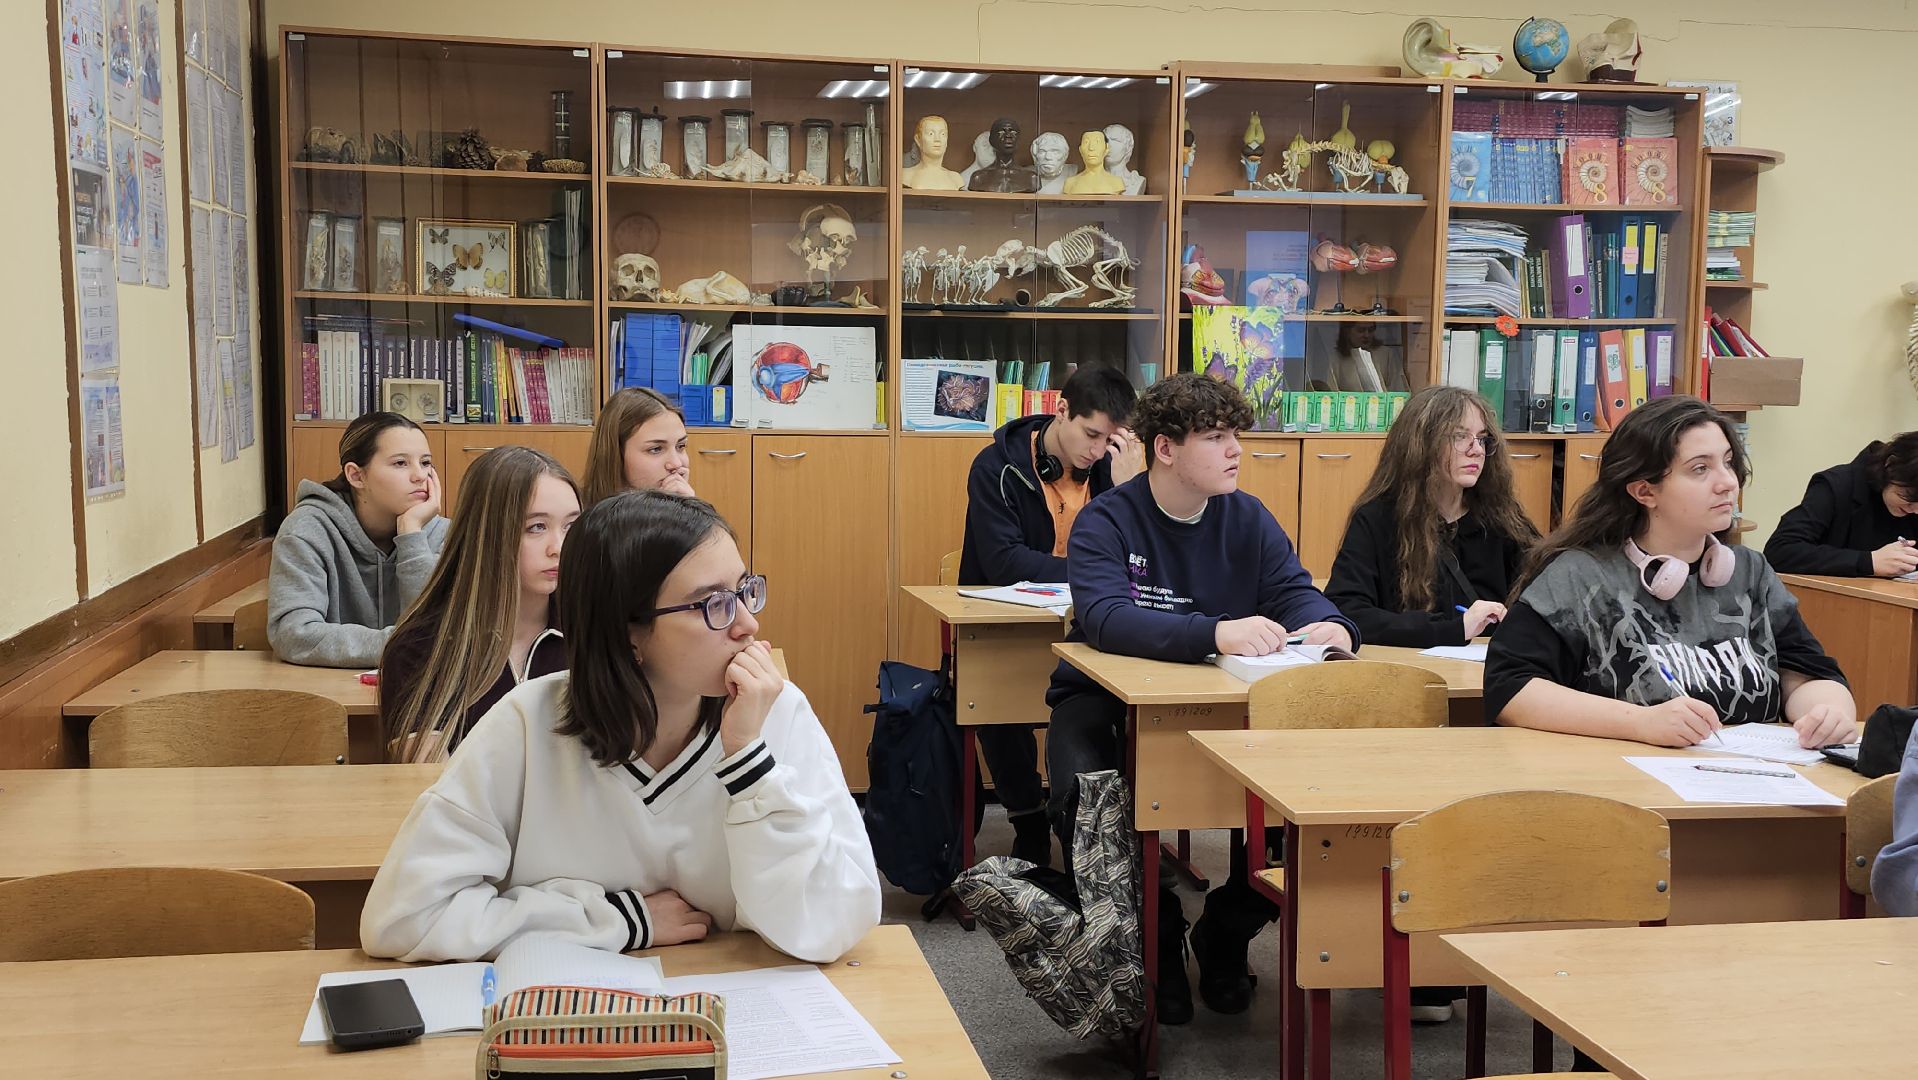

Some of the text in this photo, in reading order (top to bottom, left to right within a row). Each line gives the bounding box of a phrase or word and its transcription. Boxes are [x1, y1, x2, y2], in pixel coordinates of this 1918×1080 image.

[1727, 116, 1733, 124] 3
[1464, 176, 1476, 198] 7
[1594, 182, 1607, 203] 8
[1652, 181, 1666, 203] 8
